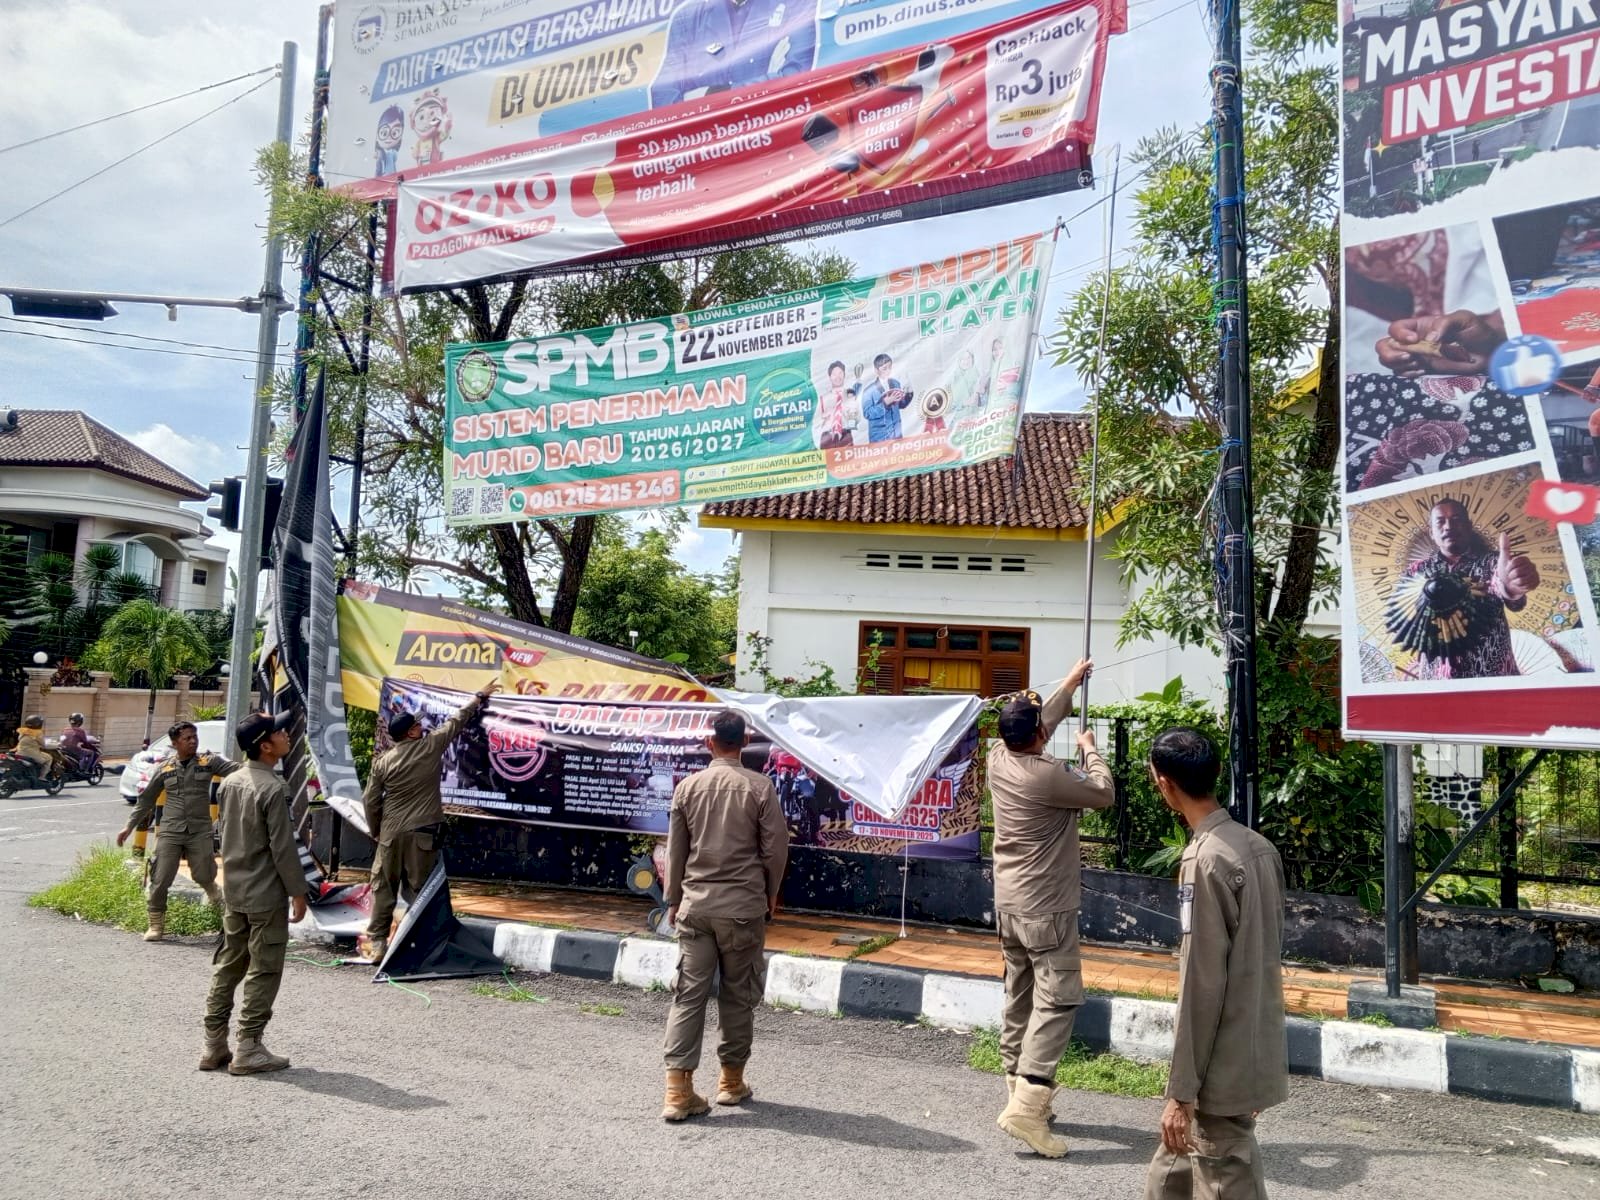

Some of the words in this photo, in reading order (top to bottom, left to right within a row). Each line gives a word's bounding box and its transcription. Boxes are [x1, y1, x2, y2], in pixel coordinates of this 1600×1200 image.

[394, 15, 457, 41] SEMARANG
[396, 3, 435, 28] DIAN
[995, 16, 1086, 56] Cashback
[383, 53, 429, 94] RAIH
[431, 24, 530, 79] PRESTASI
[501, 70, 529, 118] DI
[533, 43, 644, 109] UDINUS
[1048, 66, 1082, 96] juta
[858, 97, 914, 124] Garansi
[638, 142, 660, 159] 30
[661, 133, 713, 154] tahun
[715, 97, 812, 139] berinovasi
[865, 118, 902, 138] tukar
[633, 152, 700, 178] dengan
[700, 131, 773, 162] kualitas
[865, 137, 899, 154] baru
[635, 174, 697, 203] terbaik
[411, 236, 472, 258] PARAGON
[474, 227, 511, 247] MALL
[513, 219, 550, 239] SOLO
[647, 252, 675, 263] KANKER
[731, 237, 766, 250] LAYANAN
[765, 230, 803, 244] BERHENTI
[804, 222, 844, 235] MEROKOK
[887, 232, 1043, 294] SMPIT
[691, 309, 736, 323] JADWAL
[737, 290, 820, 316] PENDAFTARAN
[881, 268, 1040, 322] HIDAYAH
[717, 307, 805, 337] SEPTEMBER
[919, 297, 1034, 338] KLATEN
[681, 327, 716, 364] 22
[718, 332, 783, 358] NOVEMBER
[787, 326, 818, 345] 2025
[502, 322, 670, 395] SPMB
[453, 406, 546, 443] SISTEM
[550, 374, 747, 431] PENERIMAAN
[629, 426, 679, 444] TAHUN
[681, 415, 745, 437] AJARAN
[452, 445, 542, 480] MURID
[543, 433, 624, 472] BARU
[631, 433, 745, 462] 2026/2027
[834, 450, 842, 461] 2
[845, 447, 889, 460] Pilihan
[892, 436, 947, 453] Program
[863, 460, 879, 471] DAY
[891, 449, 943, 464] BOARDING
[730, 464, 754, 473] SMPIT
[756, 458, 790, 470] HIDAYAH
[792, 453, 823, 466] KLATEN
[530, 488, 564, 509] 081
[565, 485, 598, 506] 215
[600, 482, 634, 504] 215
[635, 476, 675, 500] 246
[1371, 509, 1411, 557] LUKIS
[404, 634, 496, 664] Aroma
[510, 651, 535, 664] NEW
[608, 742, 643, 753] SANKSI
[645, 744, 684, 755] PIDANA
[955, 786, 977, 806] LINE
[880, 828, 915, 839] NOVEMBER
[917, 832, 933, 840] 2025
[942, 817, 971, 830] LINE
